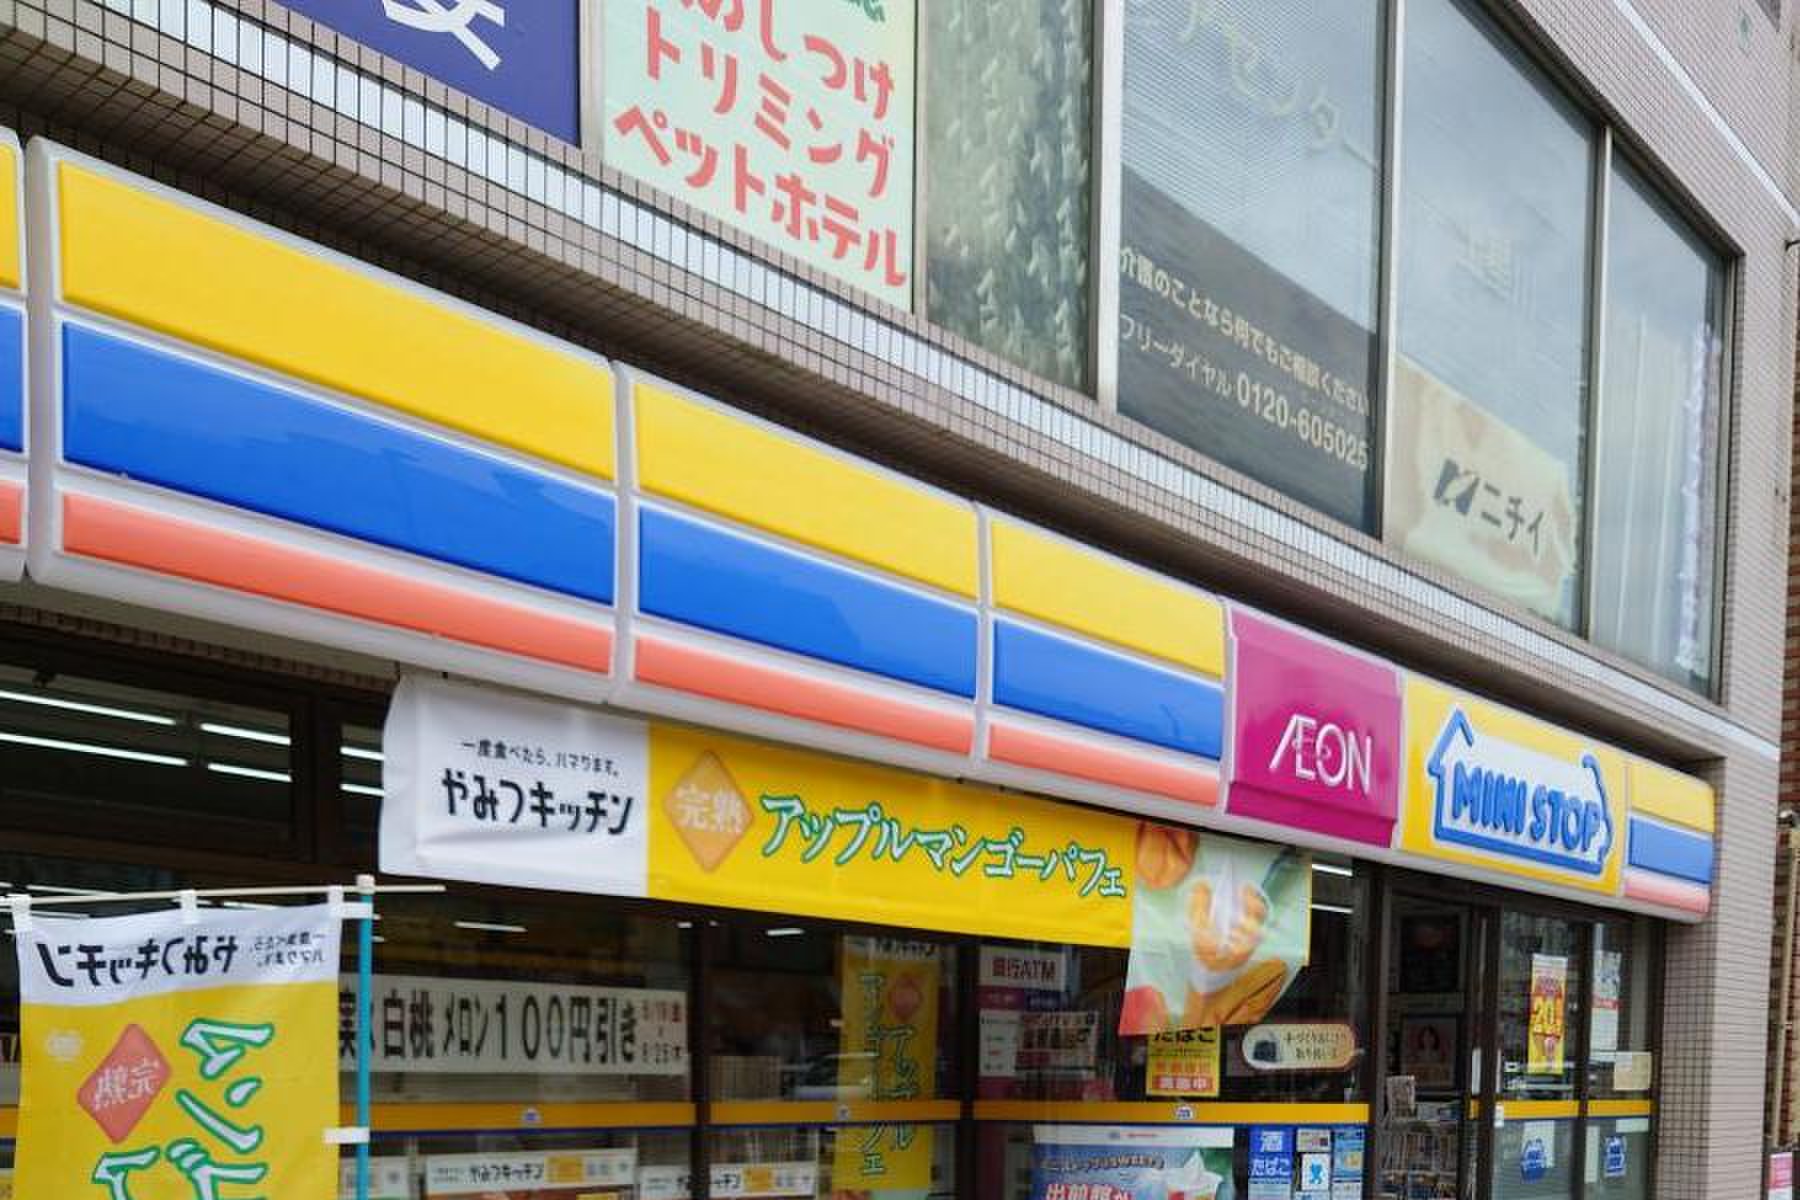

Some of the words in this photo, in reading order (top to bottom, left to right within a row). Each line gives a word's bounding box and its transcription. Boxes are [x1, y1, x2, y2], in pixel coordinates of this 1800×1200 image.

[645, 6, 896, 198] トリミング
[612, 103, 907, 288] ペットホテル
[1120, 315, 1233, 397] フリーダイヤル
[1480, 481, 1545, 557] ニチイ
[440, 767, 636, 836] やみつキッチン
[671, 782, 744, 835] 完熟
[1451, 760, 1528, 836] MINI
[1530, 784, 1601, 858] STOP
[761, 794, 1127, 899] アップルマンゴーパフェ
[1251, 1158, 1291, 1177] たばこ
